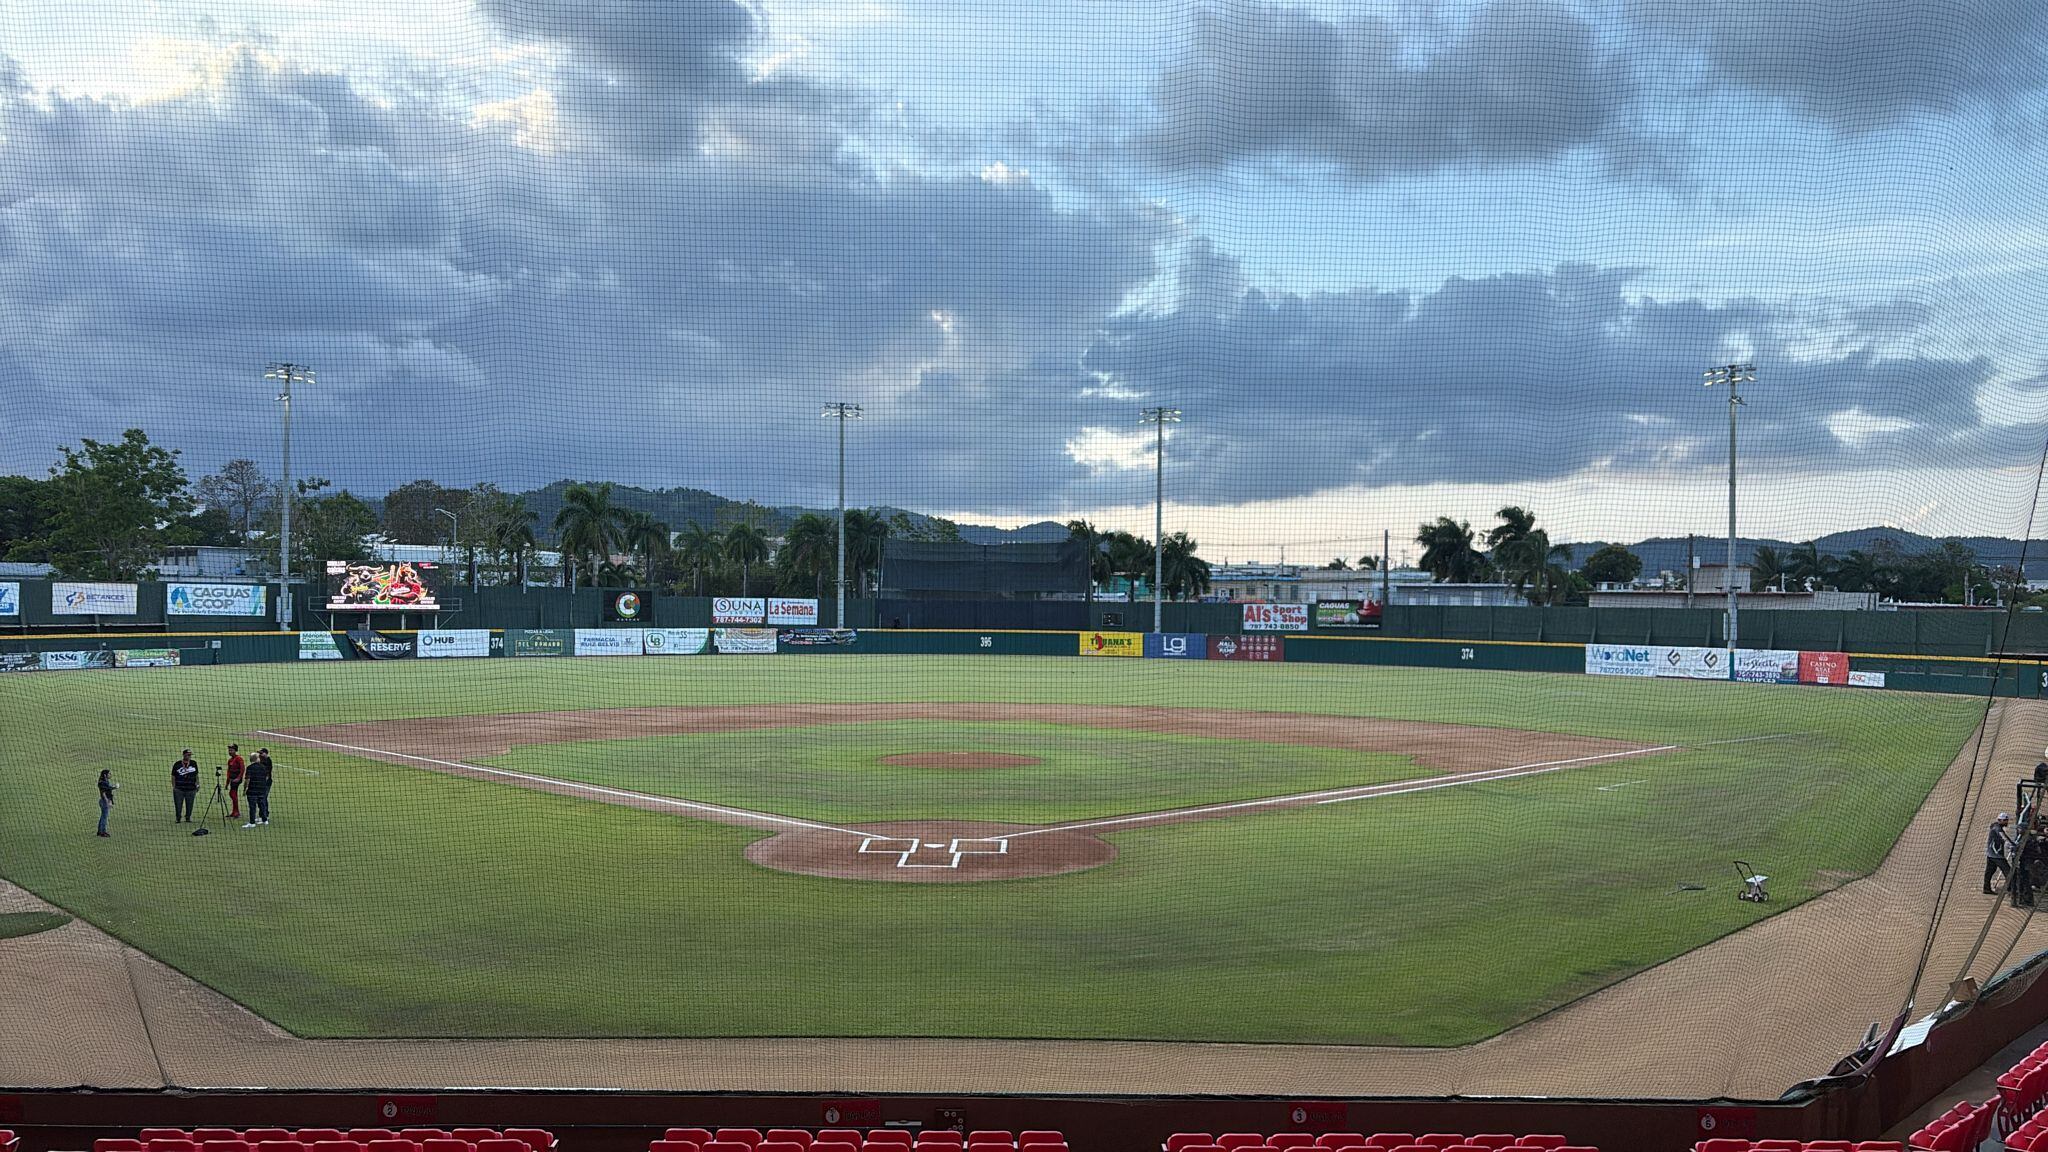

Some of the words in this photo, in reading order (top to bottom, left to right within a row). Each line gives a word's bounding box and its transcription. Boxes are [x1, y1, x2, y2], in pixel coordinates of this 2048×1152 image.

[192, 587, 251, 599] CAGUAS
[192, 599, 235, 609] COOP
[769, 601, 780, 615] La
[780, 601, 814, 616] Semana
[1244, 605, 1272, 623] Al's
[1272, 605, 1303, 617] Sport
[1281, 614, 1307, 625] Shop
[434, 636, 455, 644] HUB
[490, 637, 504, 649] 374
[980, 637, 992, 648] 395
[370, 642, 412, 652] RESERVE
[1461, 648, 1474, 660] 374
[1591, 646, 1650, 662] WorldNet
[1809, 661, 1837, 669] CASINO
